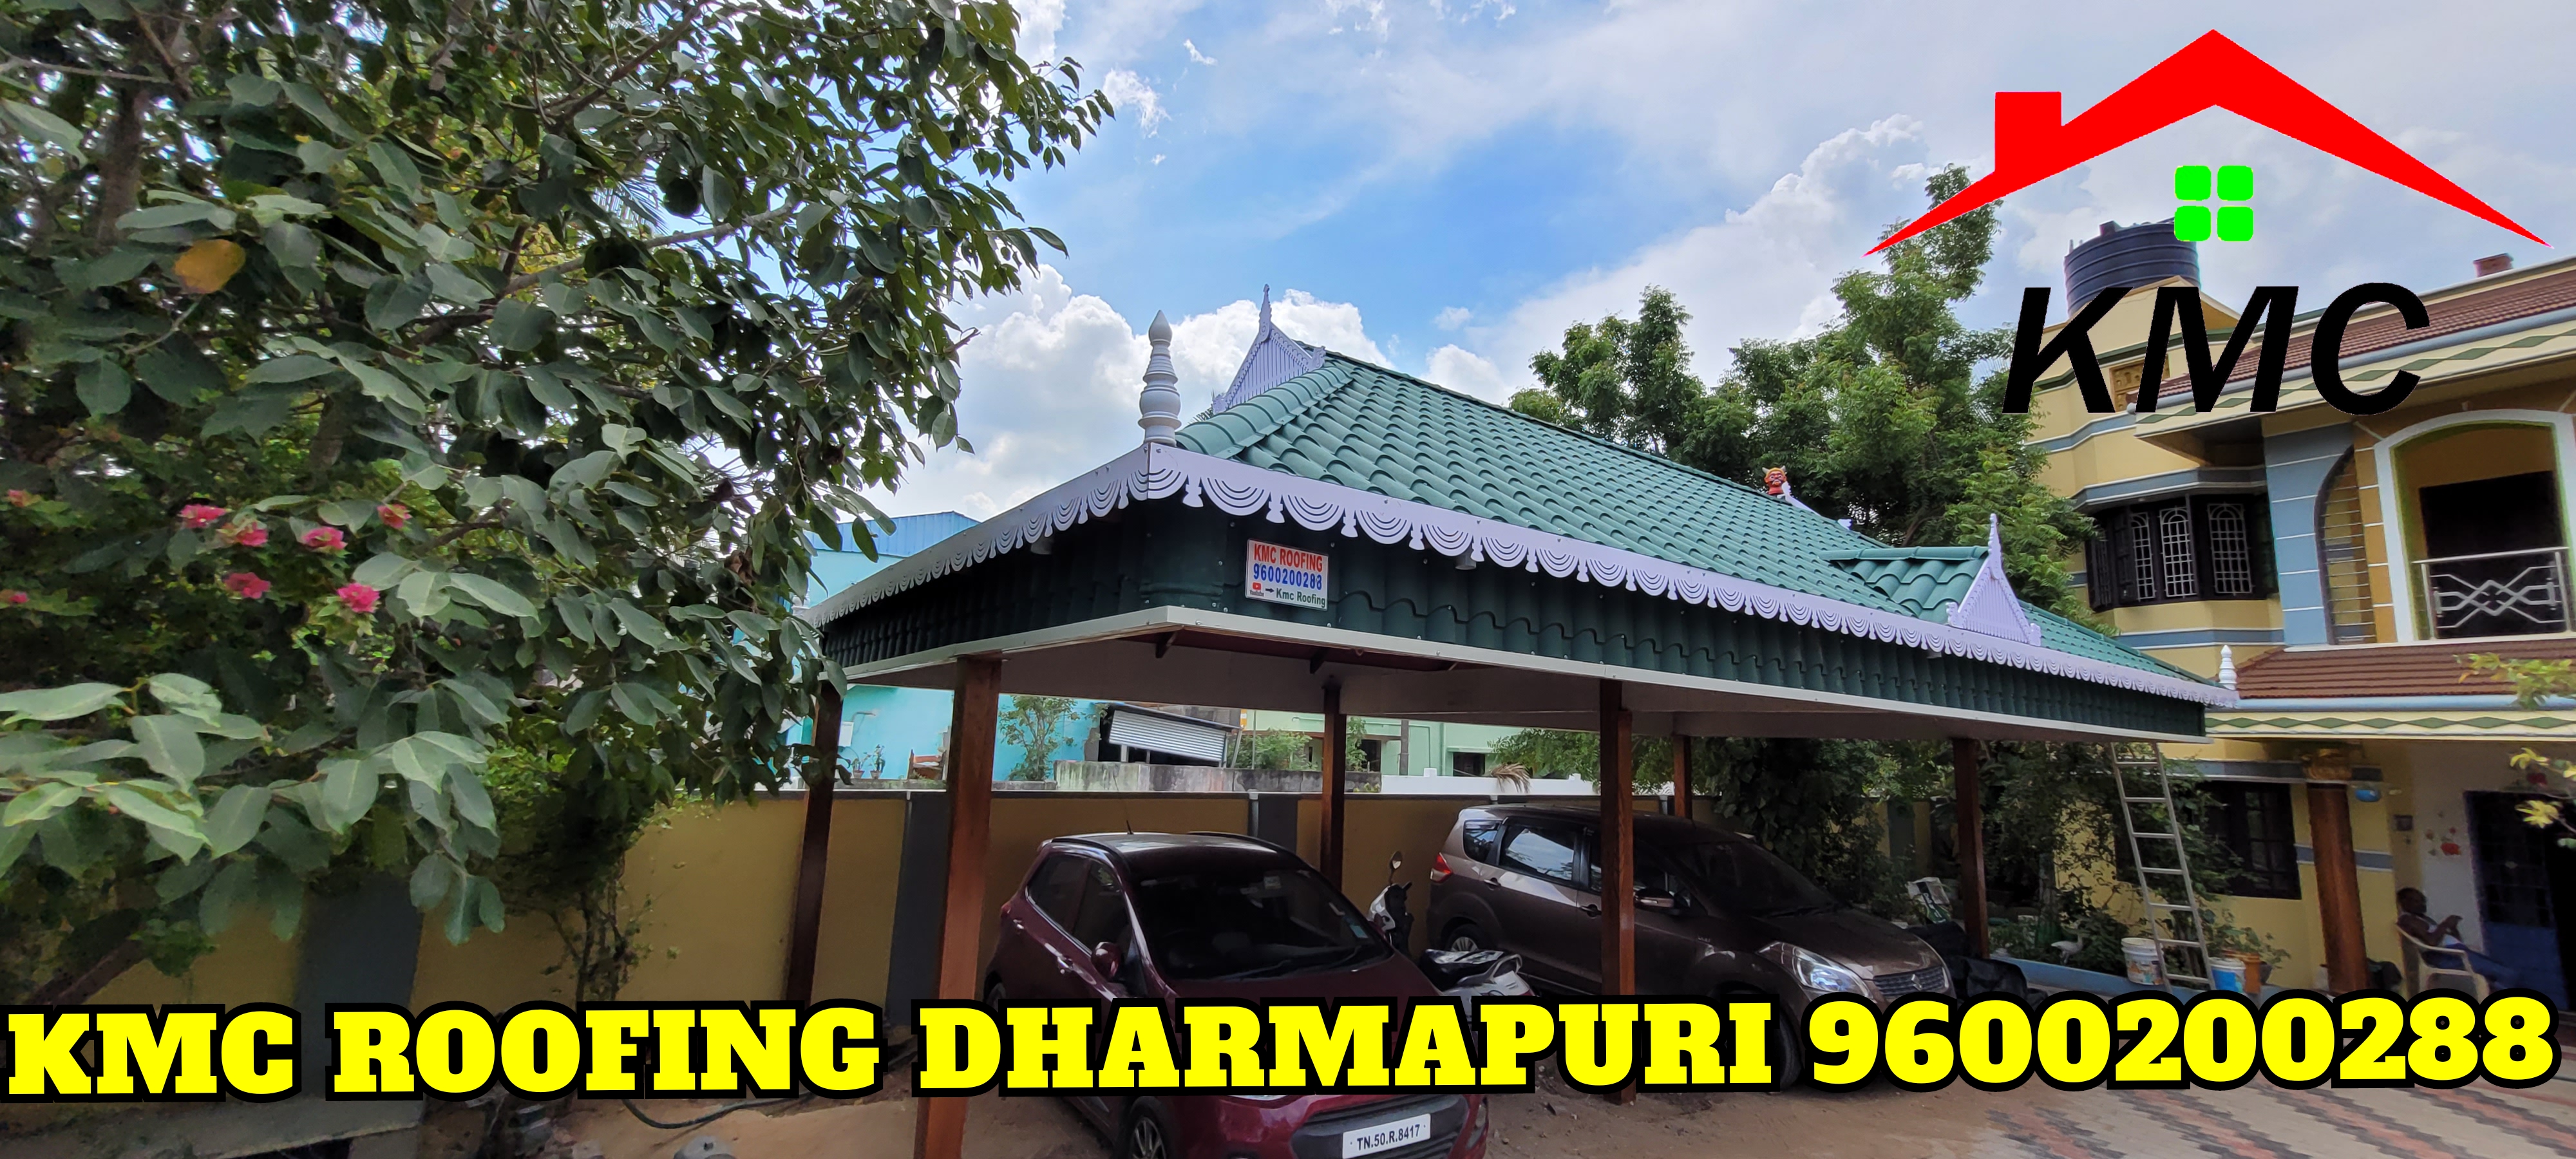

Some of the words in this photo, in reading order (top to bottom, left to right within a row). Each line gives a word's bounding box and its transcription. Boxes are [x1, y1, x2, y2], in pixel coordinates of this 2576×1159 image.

[1254, 543, 1276, 563] KMC
[1280, 549, 1323, 572] ROOFING
[1253, 563, 1322, 590] 9600200288
[1276, 587, 1294, 600] Kmc
[1297, 591, 1326, 608] Roofing
[1357, 1124, 1420, 1151] TN.50.R.8417
